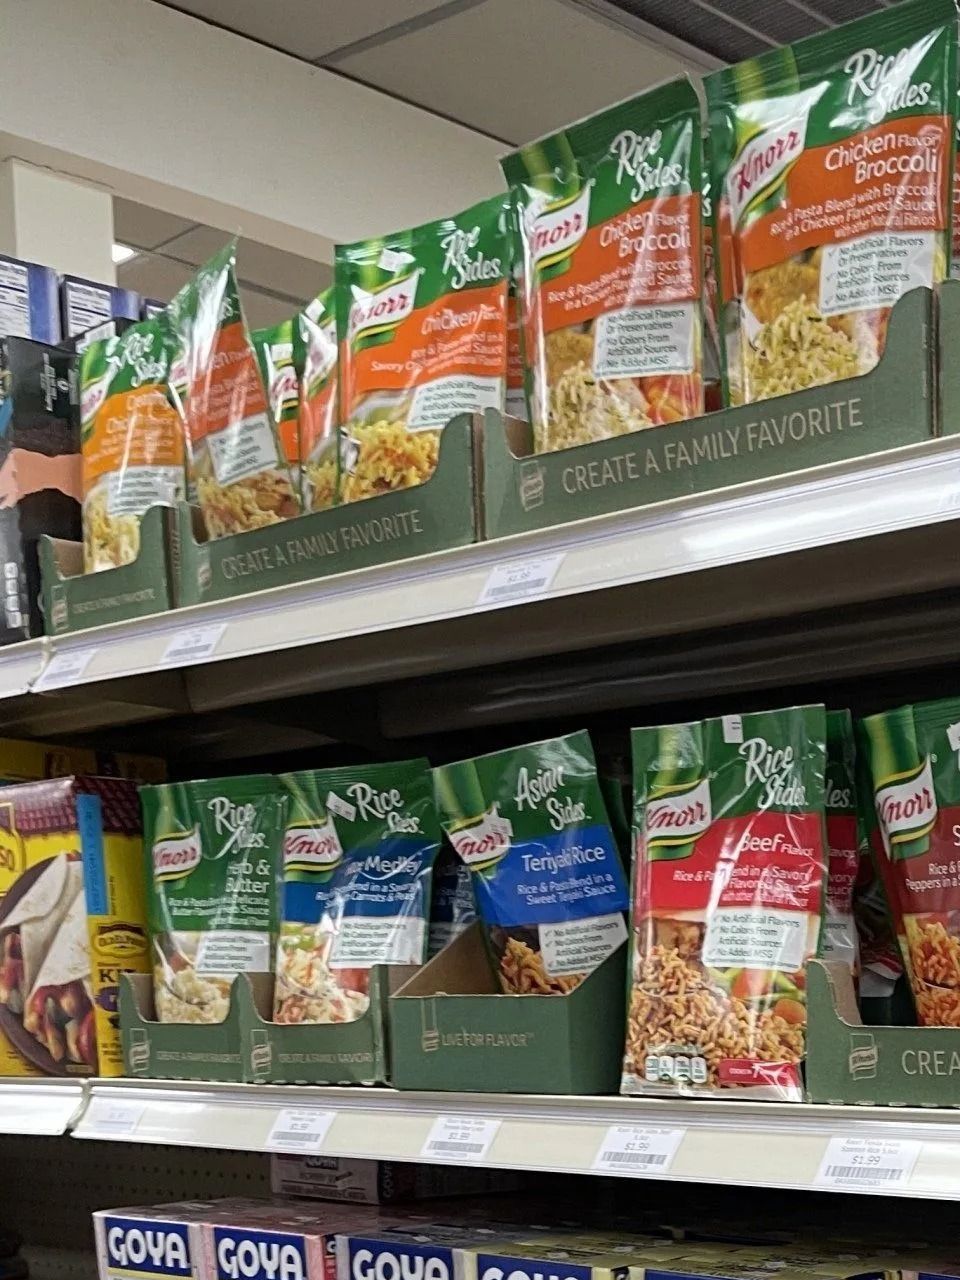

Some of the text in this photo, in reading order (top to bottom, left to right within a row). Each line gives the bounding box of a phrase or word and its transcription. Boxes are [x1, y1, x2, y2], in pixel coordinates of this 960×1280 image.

[855, 150, 937, 184] Broccoli
[562, 398, 863, 494] CREATE A FAMILY FAVORITE
[739, 738, 795, 787] Rice
[347, 782, 404, 822] Rice
[514, 765, 565, 811] Asian
[107, 1226, 188, 1269] GOYA
